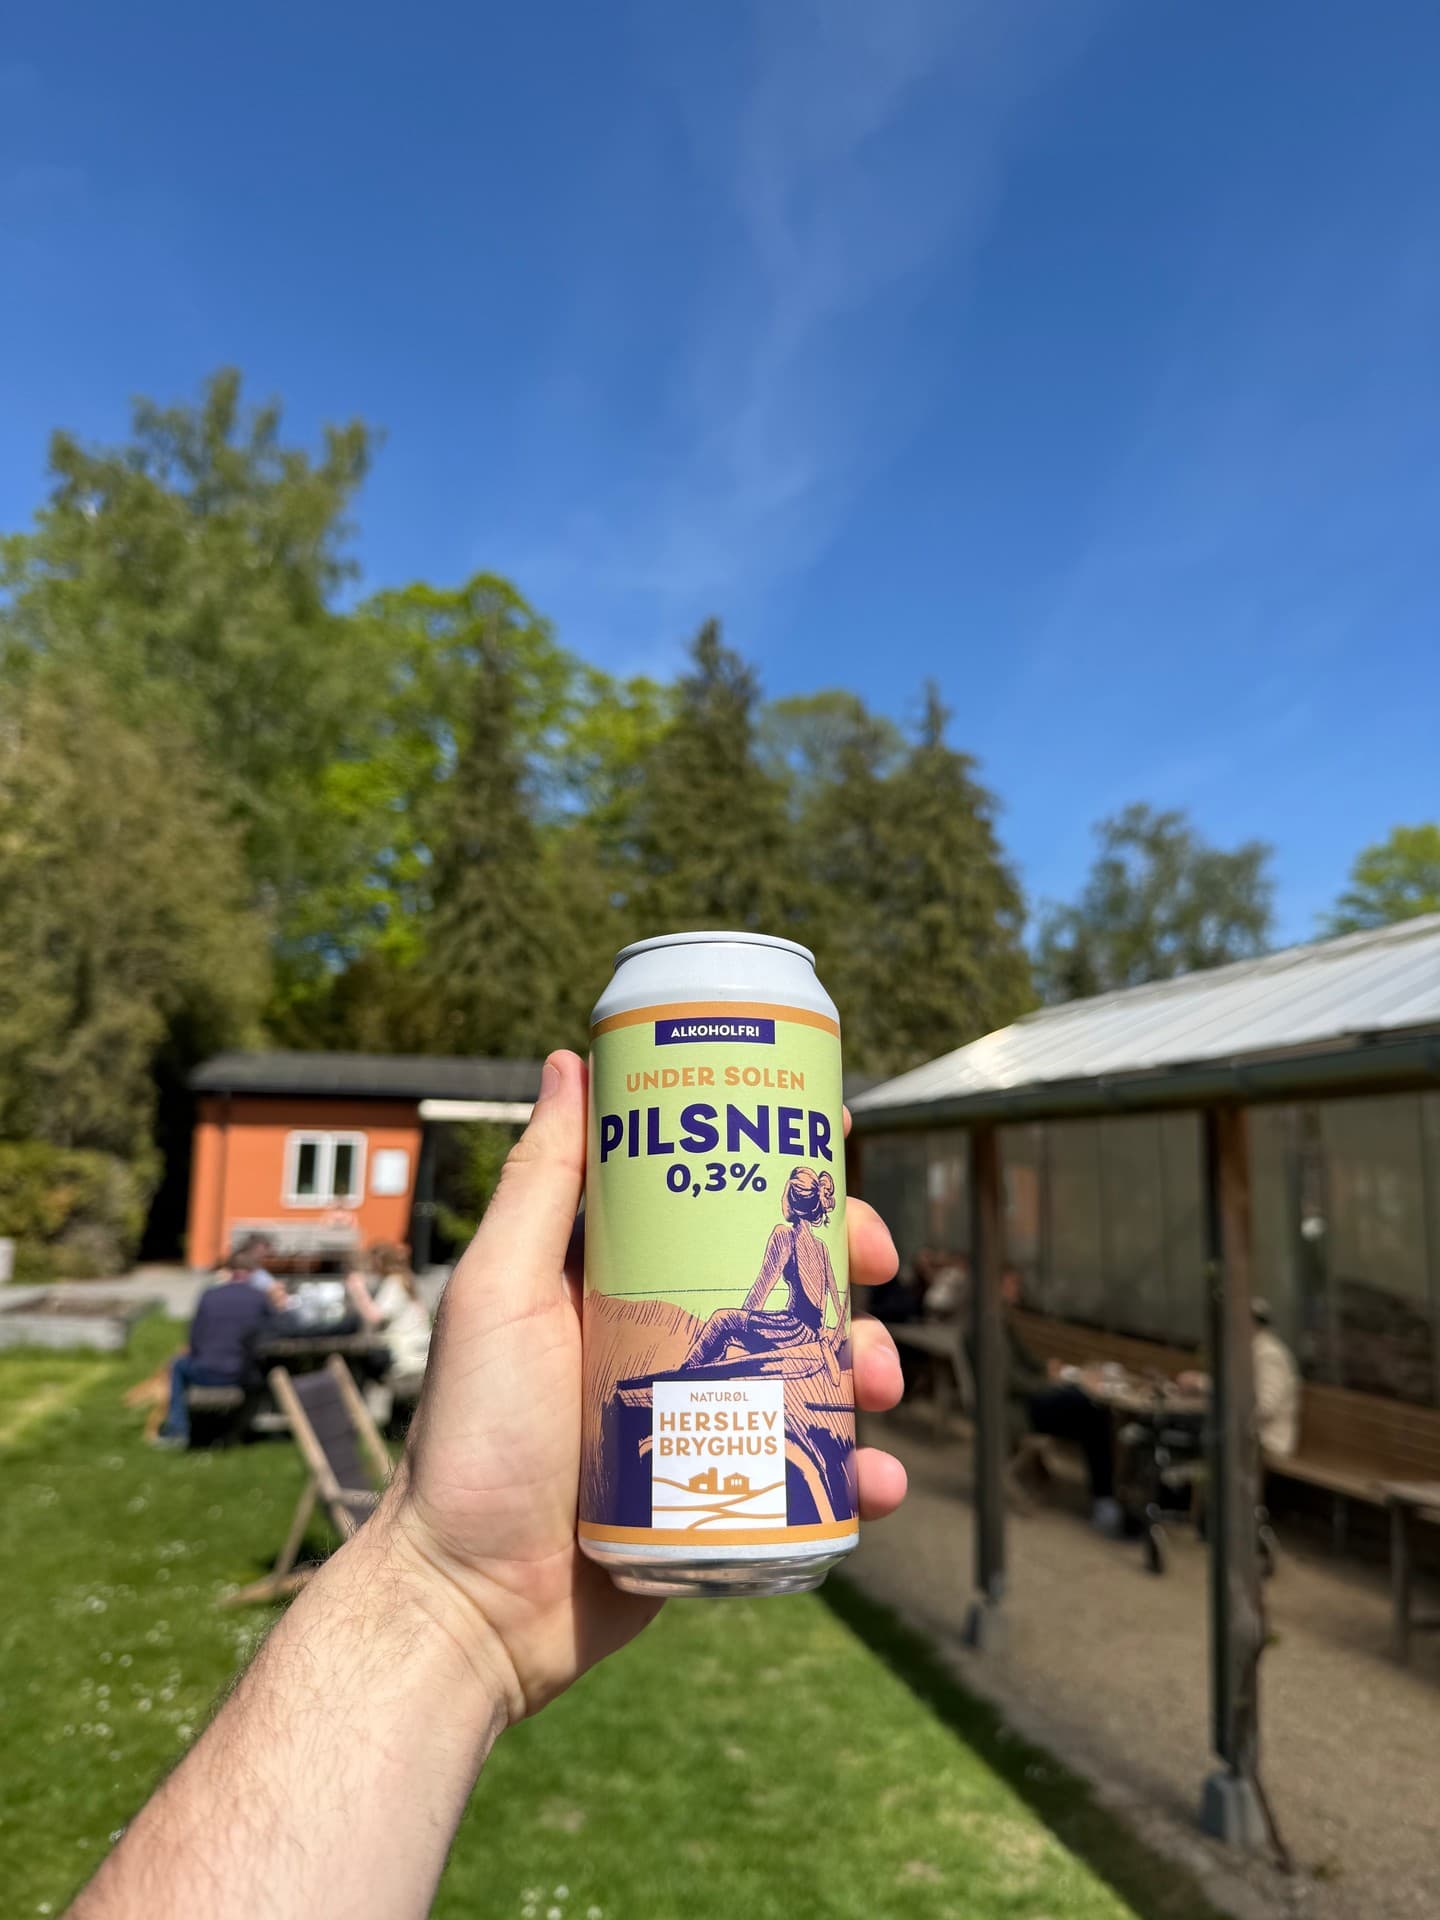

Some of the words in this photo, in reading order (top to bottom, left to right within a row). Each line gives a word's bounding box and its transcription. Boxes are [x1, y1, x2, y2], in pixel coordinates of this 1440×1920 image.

[671, 1024, 760, 1038] ALKOHOLFRI
[626, 1066, 714, 1093] UNDER
[724, 1066, 805, 1091] SOLEN
[600, 1103, 833, 1163] PILSNER
[666, 1162, 767, 1198] 0,3%
[690, 1391, 749, 1403] NATURØL
[659, 1411, 778, 1432] HERSLEV
[659, 1436, 778, 1457] BRYGHUS
